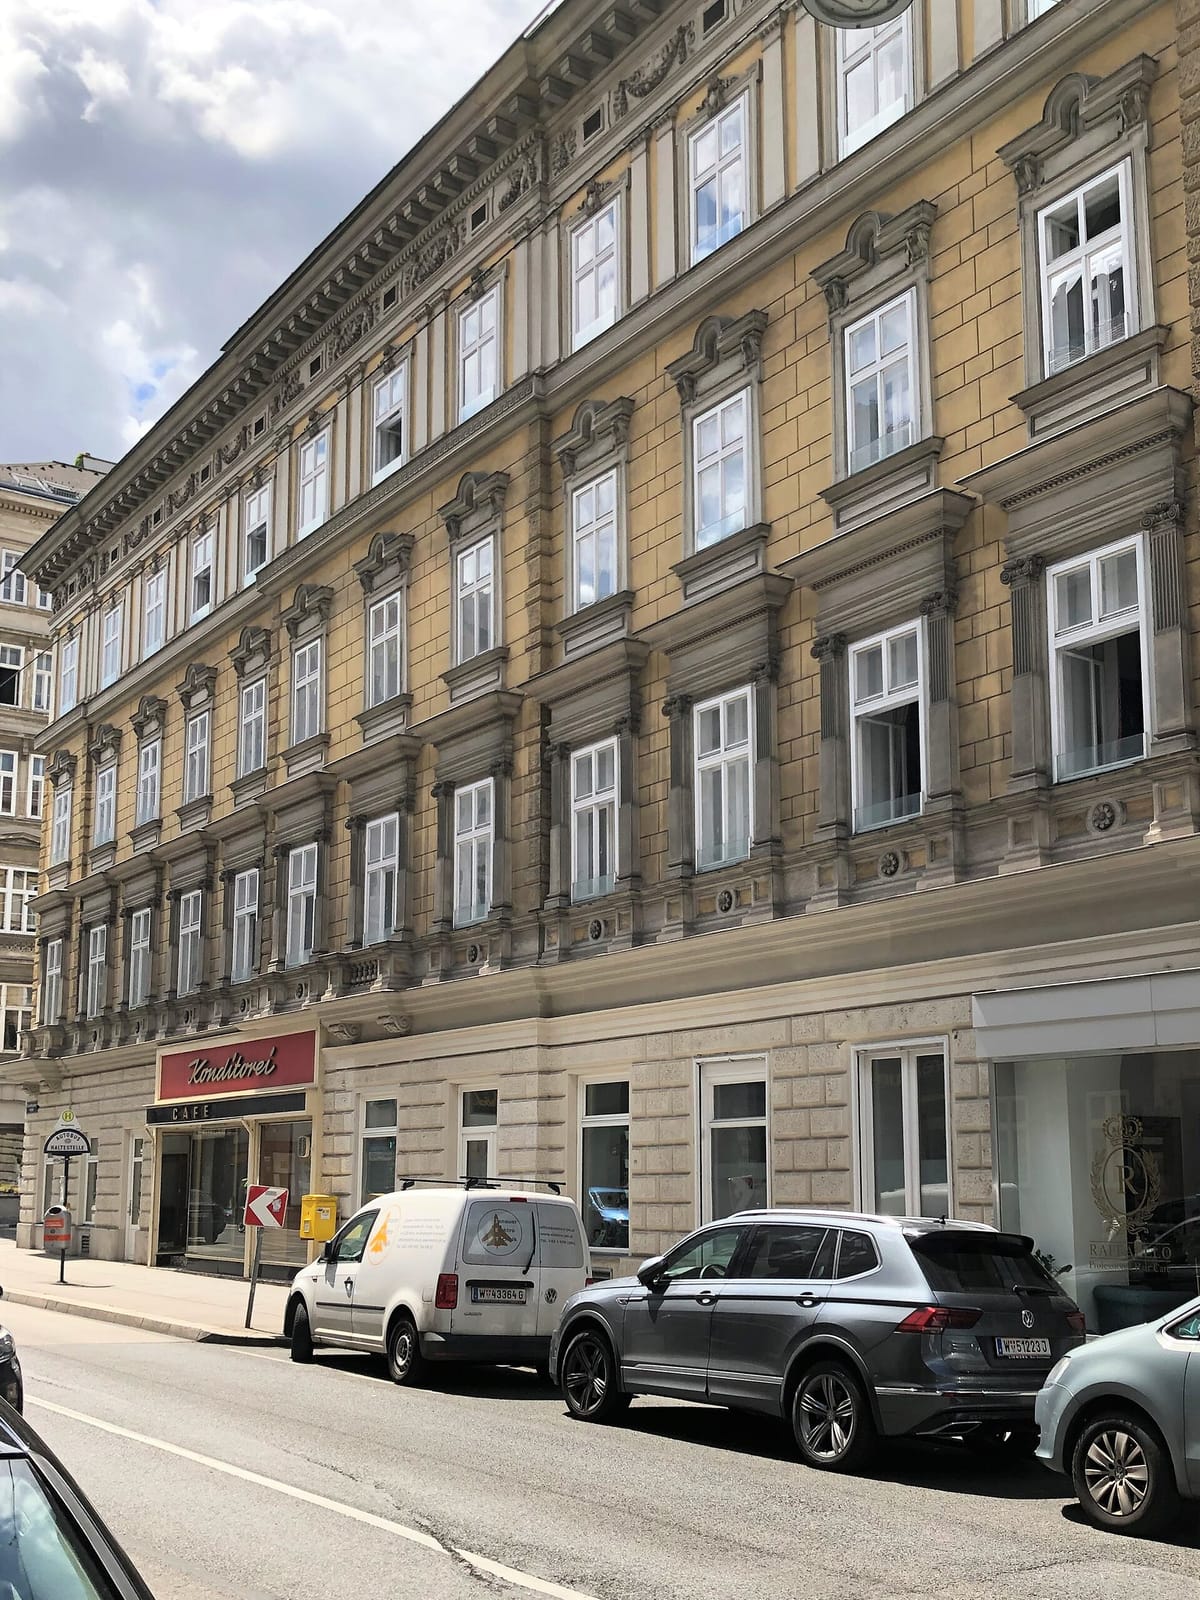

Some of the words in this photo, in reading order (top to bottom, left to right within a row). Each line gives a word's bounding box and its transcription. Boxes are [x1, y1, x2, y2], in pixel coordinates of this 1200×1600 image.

[188, 1046, 276, 1084] Konditorei
[172, 1105, 209, 1120] CAFE
[56, 1132, 81, 1142] AUTOBUS
[1114, 1165, 1139, 1195] R
